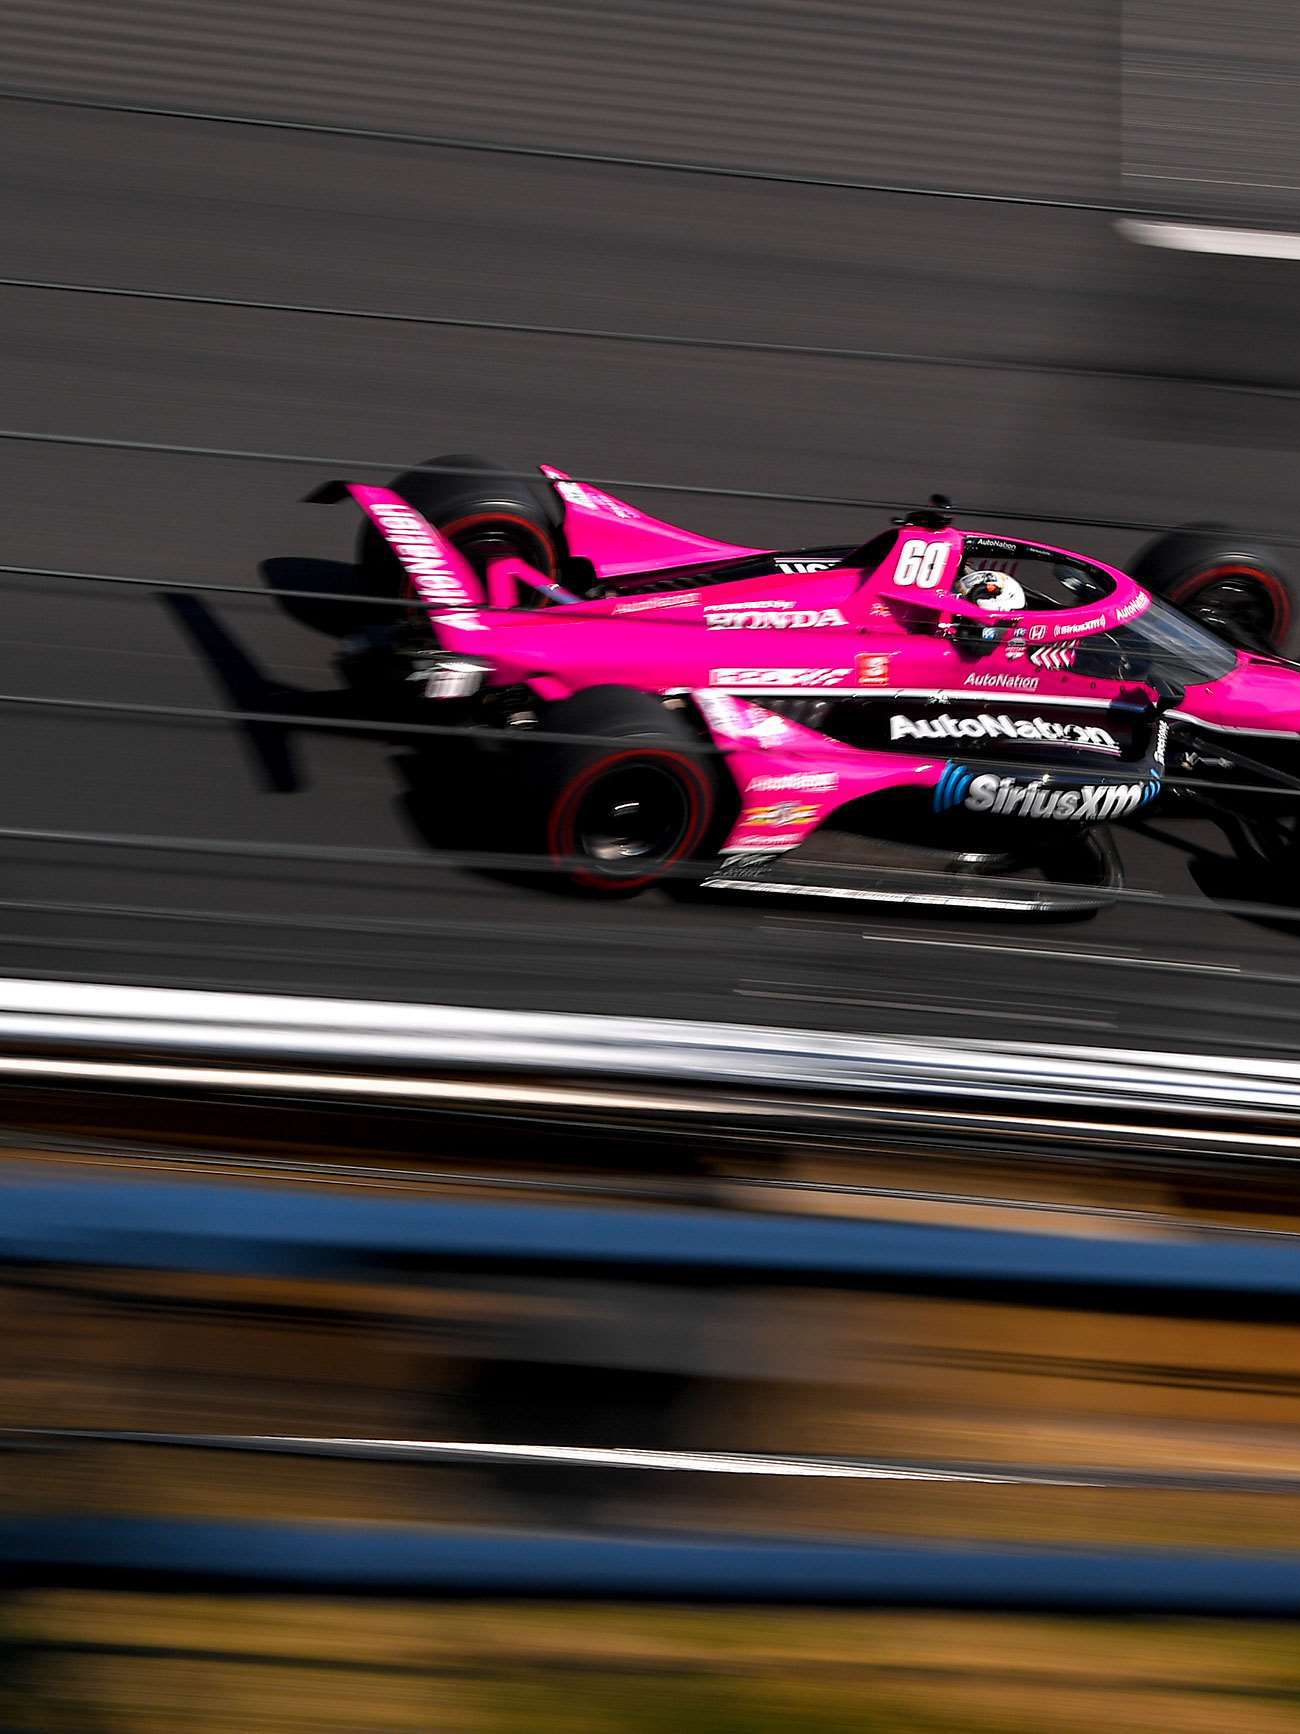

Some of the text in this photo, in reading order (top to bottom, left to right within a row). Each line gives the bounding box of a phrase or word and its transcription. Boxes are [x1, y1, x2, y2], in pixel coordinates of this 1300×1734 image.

[976, 537, 1017, 552] AutoNation
[893, 539, 952, 590] 60
[703, 608, 849, 631] HONDA
[963, 672, 1039, 691] AutoNation
[890, 713, 1119, 749] AutoNation
[965, 773, 1145, 821] SiriusXM
